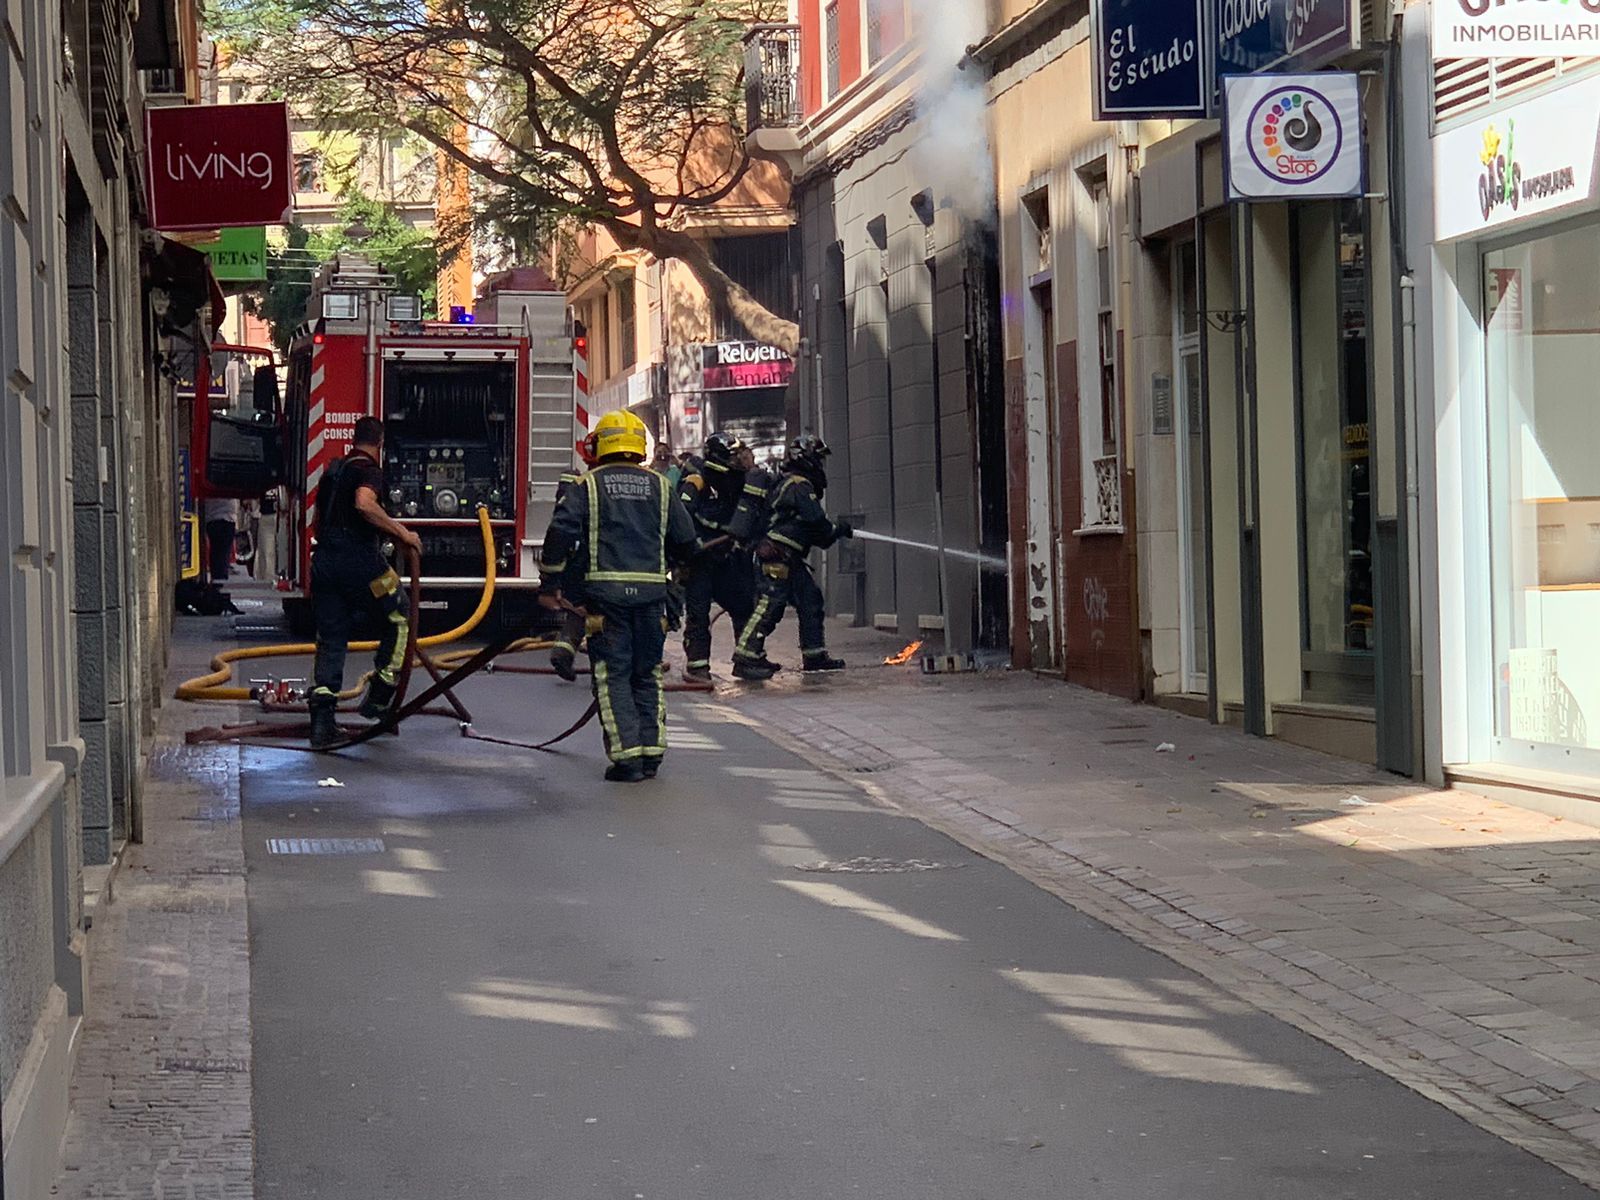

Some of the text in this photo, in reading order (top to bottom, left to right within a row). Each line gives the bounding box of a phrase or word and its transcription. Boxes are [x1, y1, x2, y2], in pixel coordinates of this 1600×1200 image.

[1109, 24, 1136, 60] El
[1107, 37, 1194, 92] Escudo
[1276, 154, 1318, 177] Stop
[722, 367, 791, 388] leman
[603, 474, 650, 485] BOMBEROS
[605, 483, 651, 496] TENERIFE
